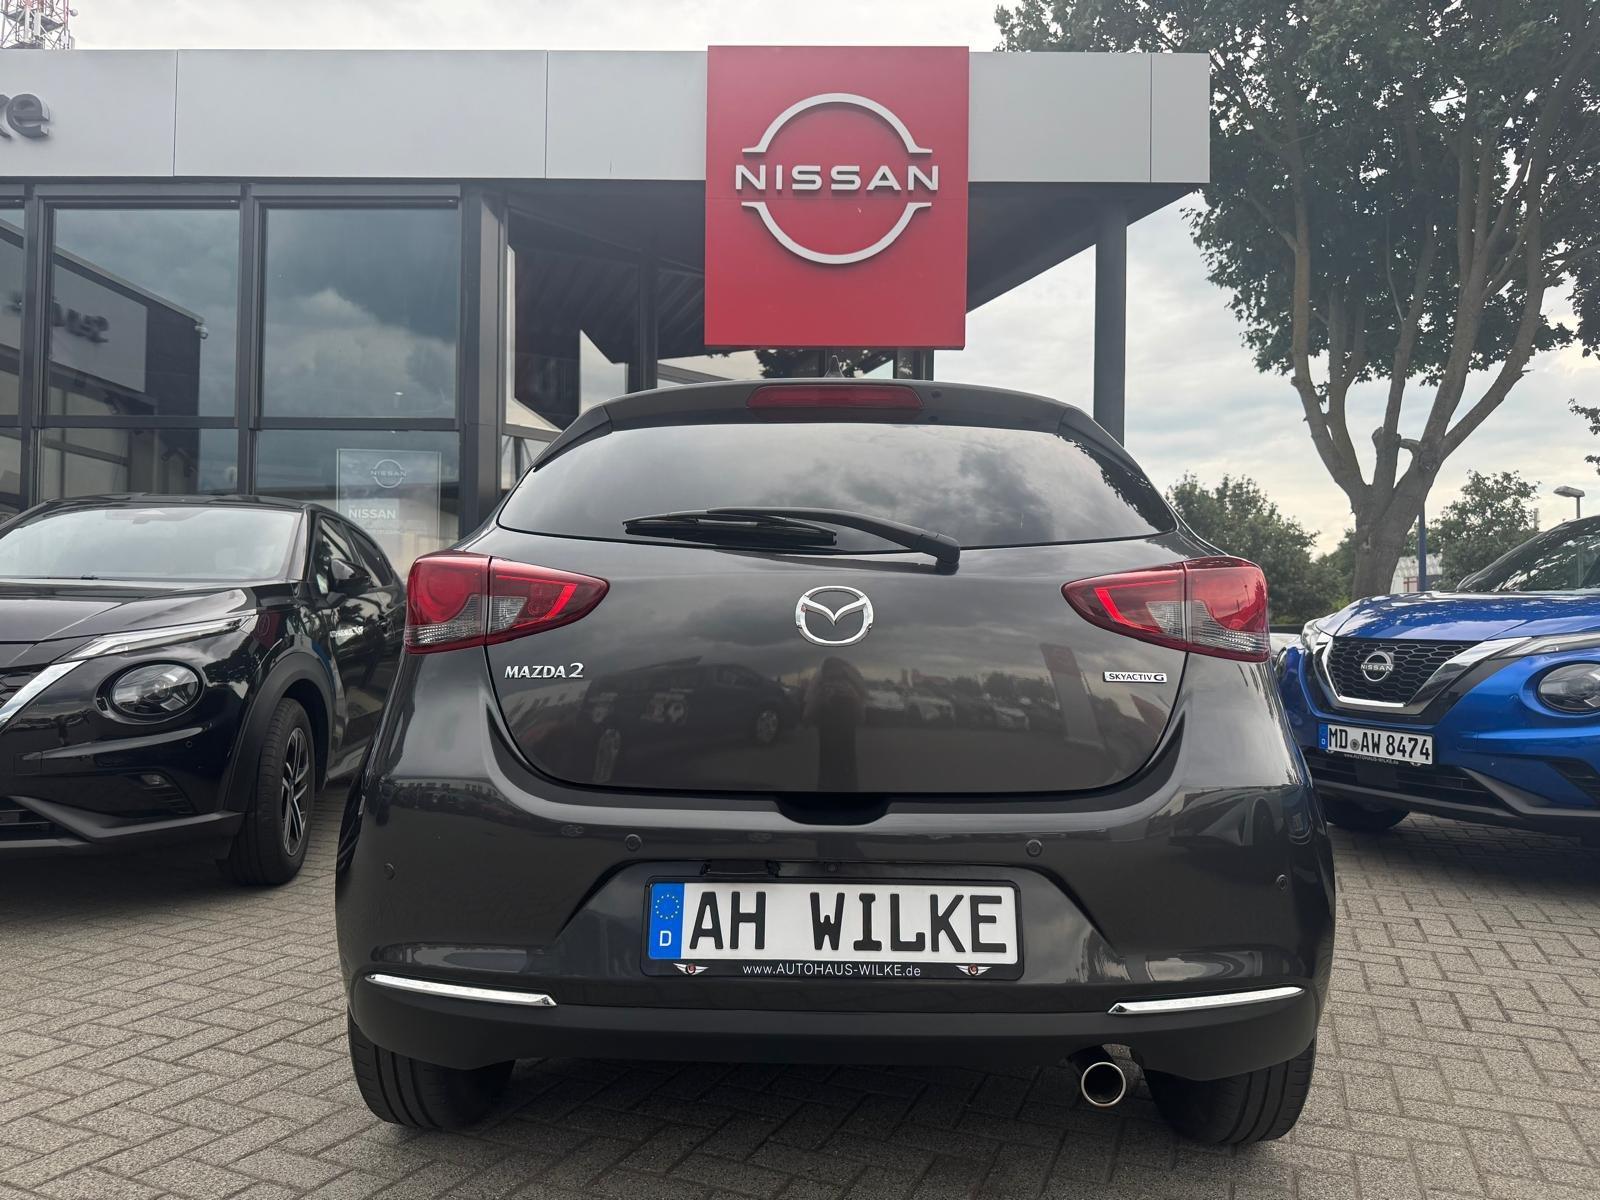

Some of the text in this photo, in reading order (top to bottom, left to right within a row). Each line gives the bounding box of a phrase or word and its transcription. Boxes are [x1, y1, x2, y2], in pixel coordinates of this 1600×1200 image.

[735, 164, 939, 191] NISSAN
[348, 508, 396, 519] NISSAN
[1360, 664, 1394, 672] NISSAN
[1328, 727, 1431, 761] MD AW 8474
[689, 891, 1007, 953] AH WILKE
[659, 930, 672, 947] D
[742, 963, 921, 977] www.AUTOHAUS-WILKE.de
